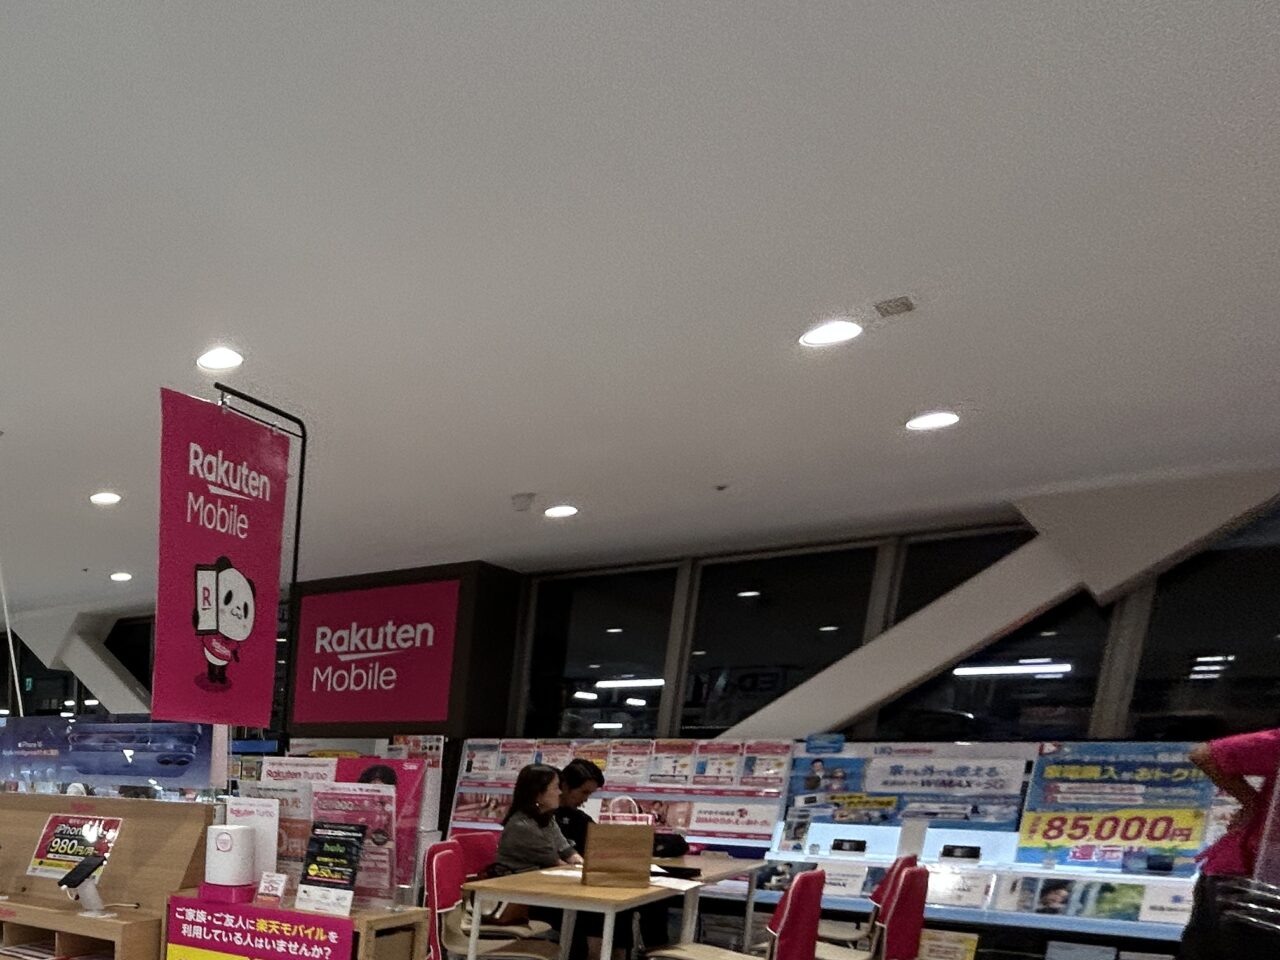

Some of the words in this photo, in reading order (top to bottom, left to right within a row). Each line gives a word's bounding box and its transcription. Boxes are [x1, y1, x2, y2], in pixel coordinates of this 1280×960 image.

[189, 442, 270, 501] Rakuten
[187, 491, 248, 538] Mobile
[315, 621, 434, 655] Rakuten
[312, 662, 397, 692] Mobile
[175, 907, 338, 944] ご家族・ご友人に楽天モバイルを
[181, 923, 332, 960] 利用している人はいませんか?
